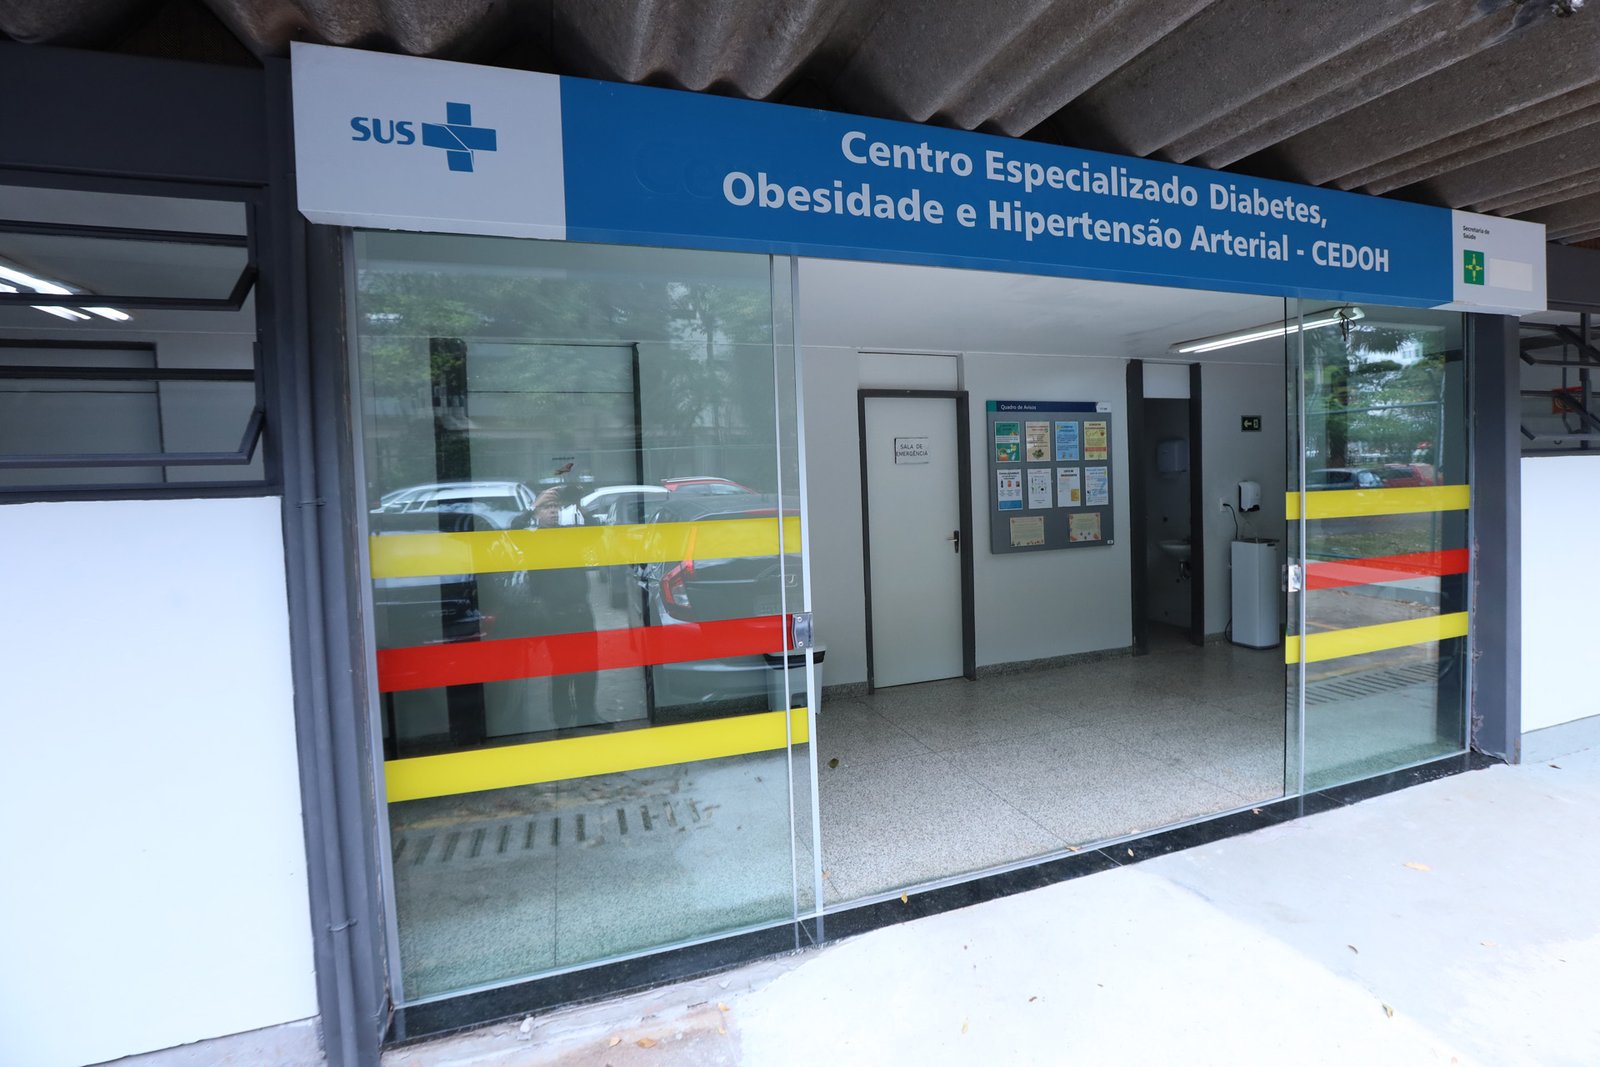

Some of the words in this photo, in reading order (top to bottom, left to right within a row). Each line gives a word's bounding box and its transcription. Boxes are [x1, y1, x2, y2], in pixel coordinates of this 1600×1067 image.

[350, 116, 416, 146] SUS
[841, 131, 974, 177] Centro
[986, 150, 1198, 207] Especializado
[1210, 183, 1327, 228] Diabetes,
[722, 171, 944, 225] Obesidade
[956, 203, 978, 229] e
[989, 200, 1182, 249] Hipertensão
[1190, 226, 1289, 261] Arterial
[1312, 240, 1390, 273] CEDOH
[1463, 225, 1484, 234] Secretaria
